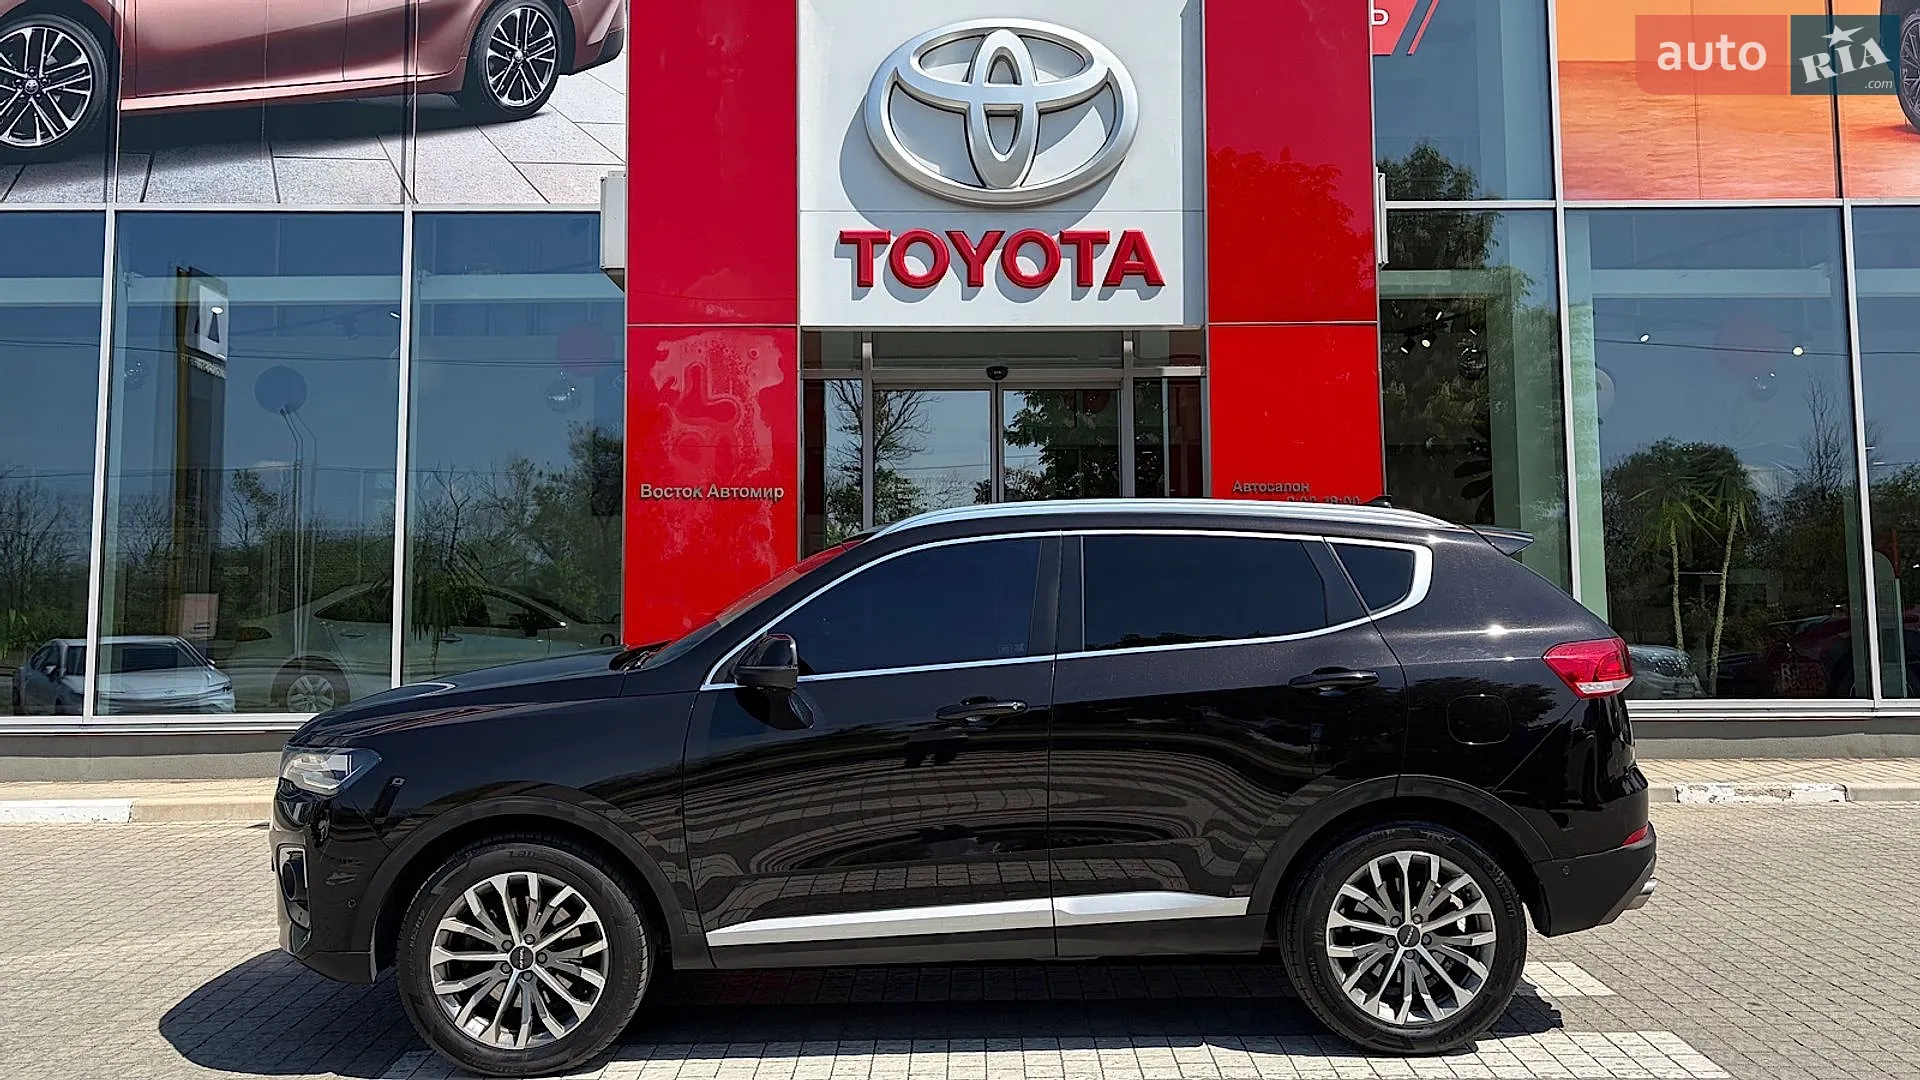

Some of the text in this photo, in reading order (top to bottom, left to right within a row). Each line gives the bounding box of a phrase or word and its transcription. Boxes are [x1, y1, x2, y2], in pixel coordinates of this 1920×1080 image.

[839, 228, 1166, 289] TOYOTA
[640, 483, 785, 501] Восток Автомир
[1232, 480, 1310, 492] Автосалон
